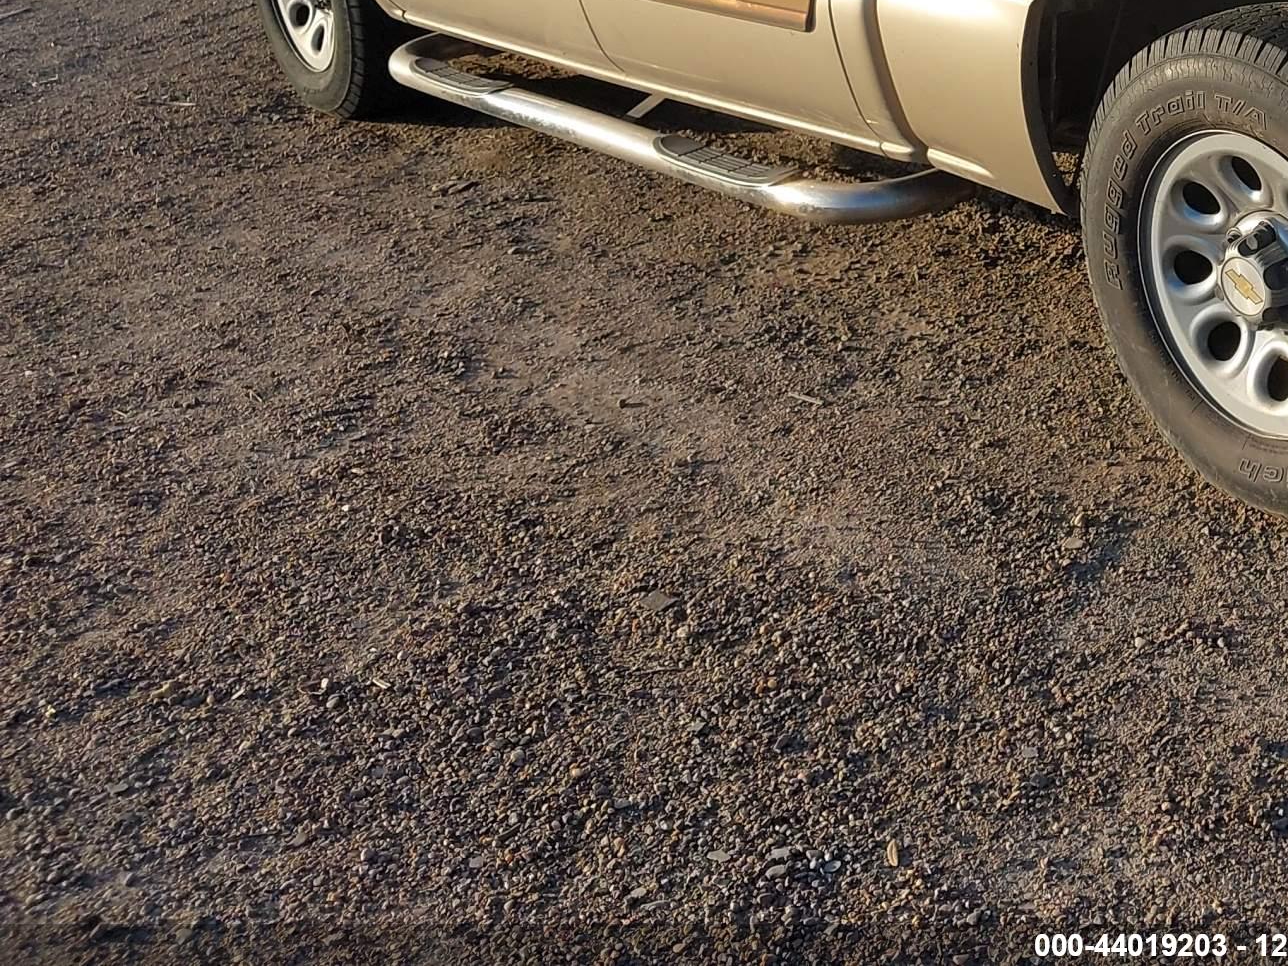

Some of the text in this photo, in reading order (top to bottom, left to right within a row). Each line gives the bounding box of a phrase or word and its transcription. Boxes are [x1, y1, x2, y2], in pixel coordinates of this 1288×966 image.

[1102, 90, 1268, 290] Rugged Trail T/A
